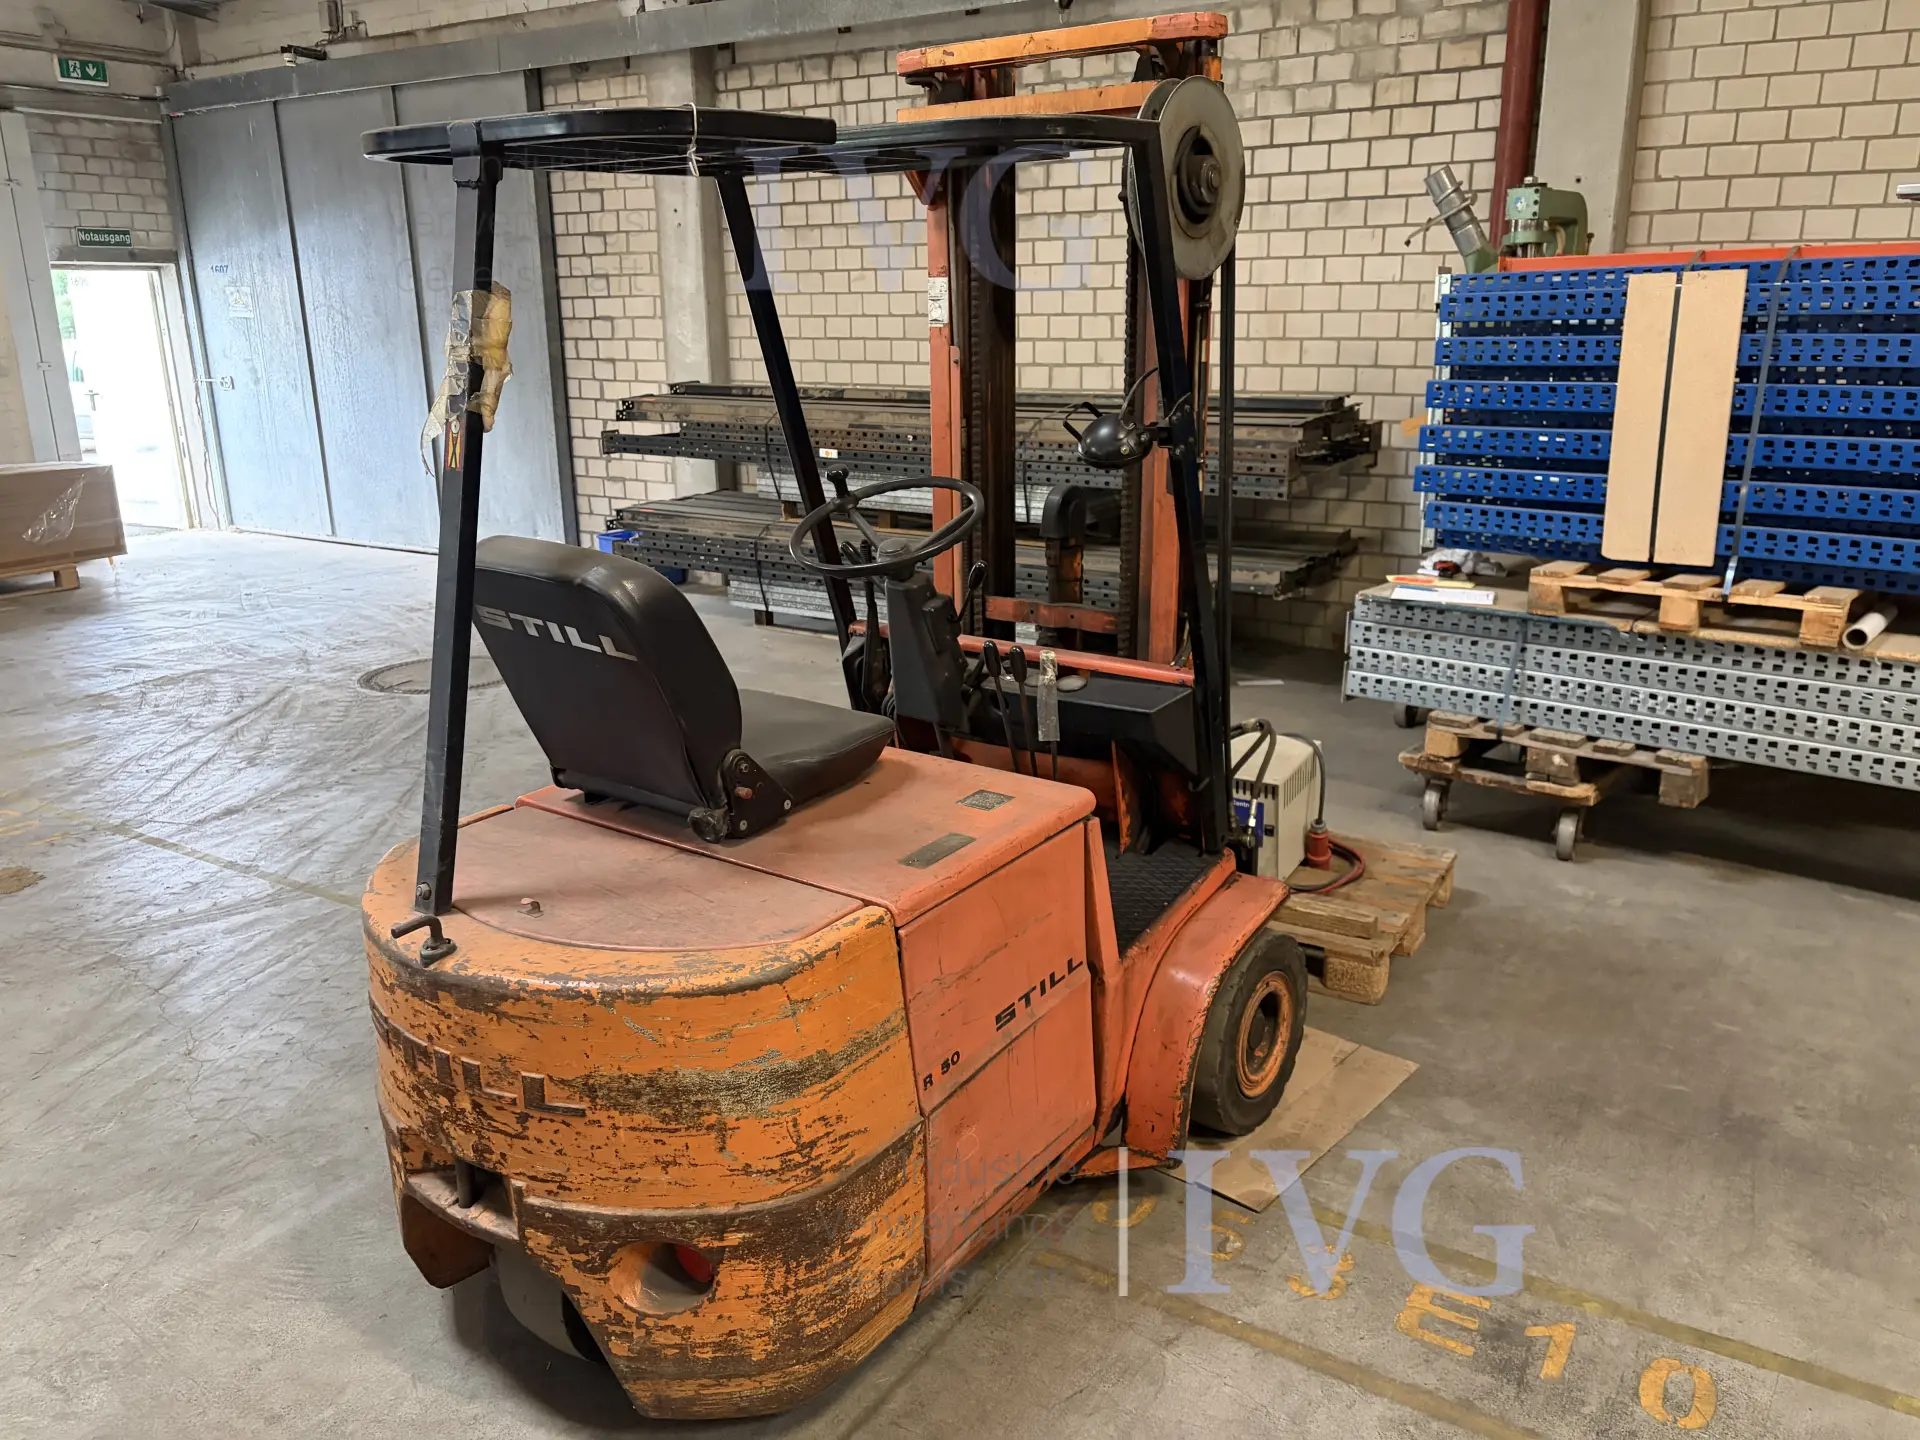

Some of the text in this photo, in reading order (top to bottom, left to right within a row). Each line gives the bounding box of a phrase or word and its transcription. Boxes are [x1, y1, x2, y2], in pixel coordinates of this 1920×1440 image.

[78, 231, 131, 244] Notausgang
[210, 264, 229, 274] 1607
[475, 604, 638, 662] STILL
[995, 957, 1083, 1032] STILL
[923, 1050, 961, 1091] R 50
